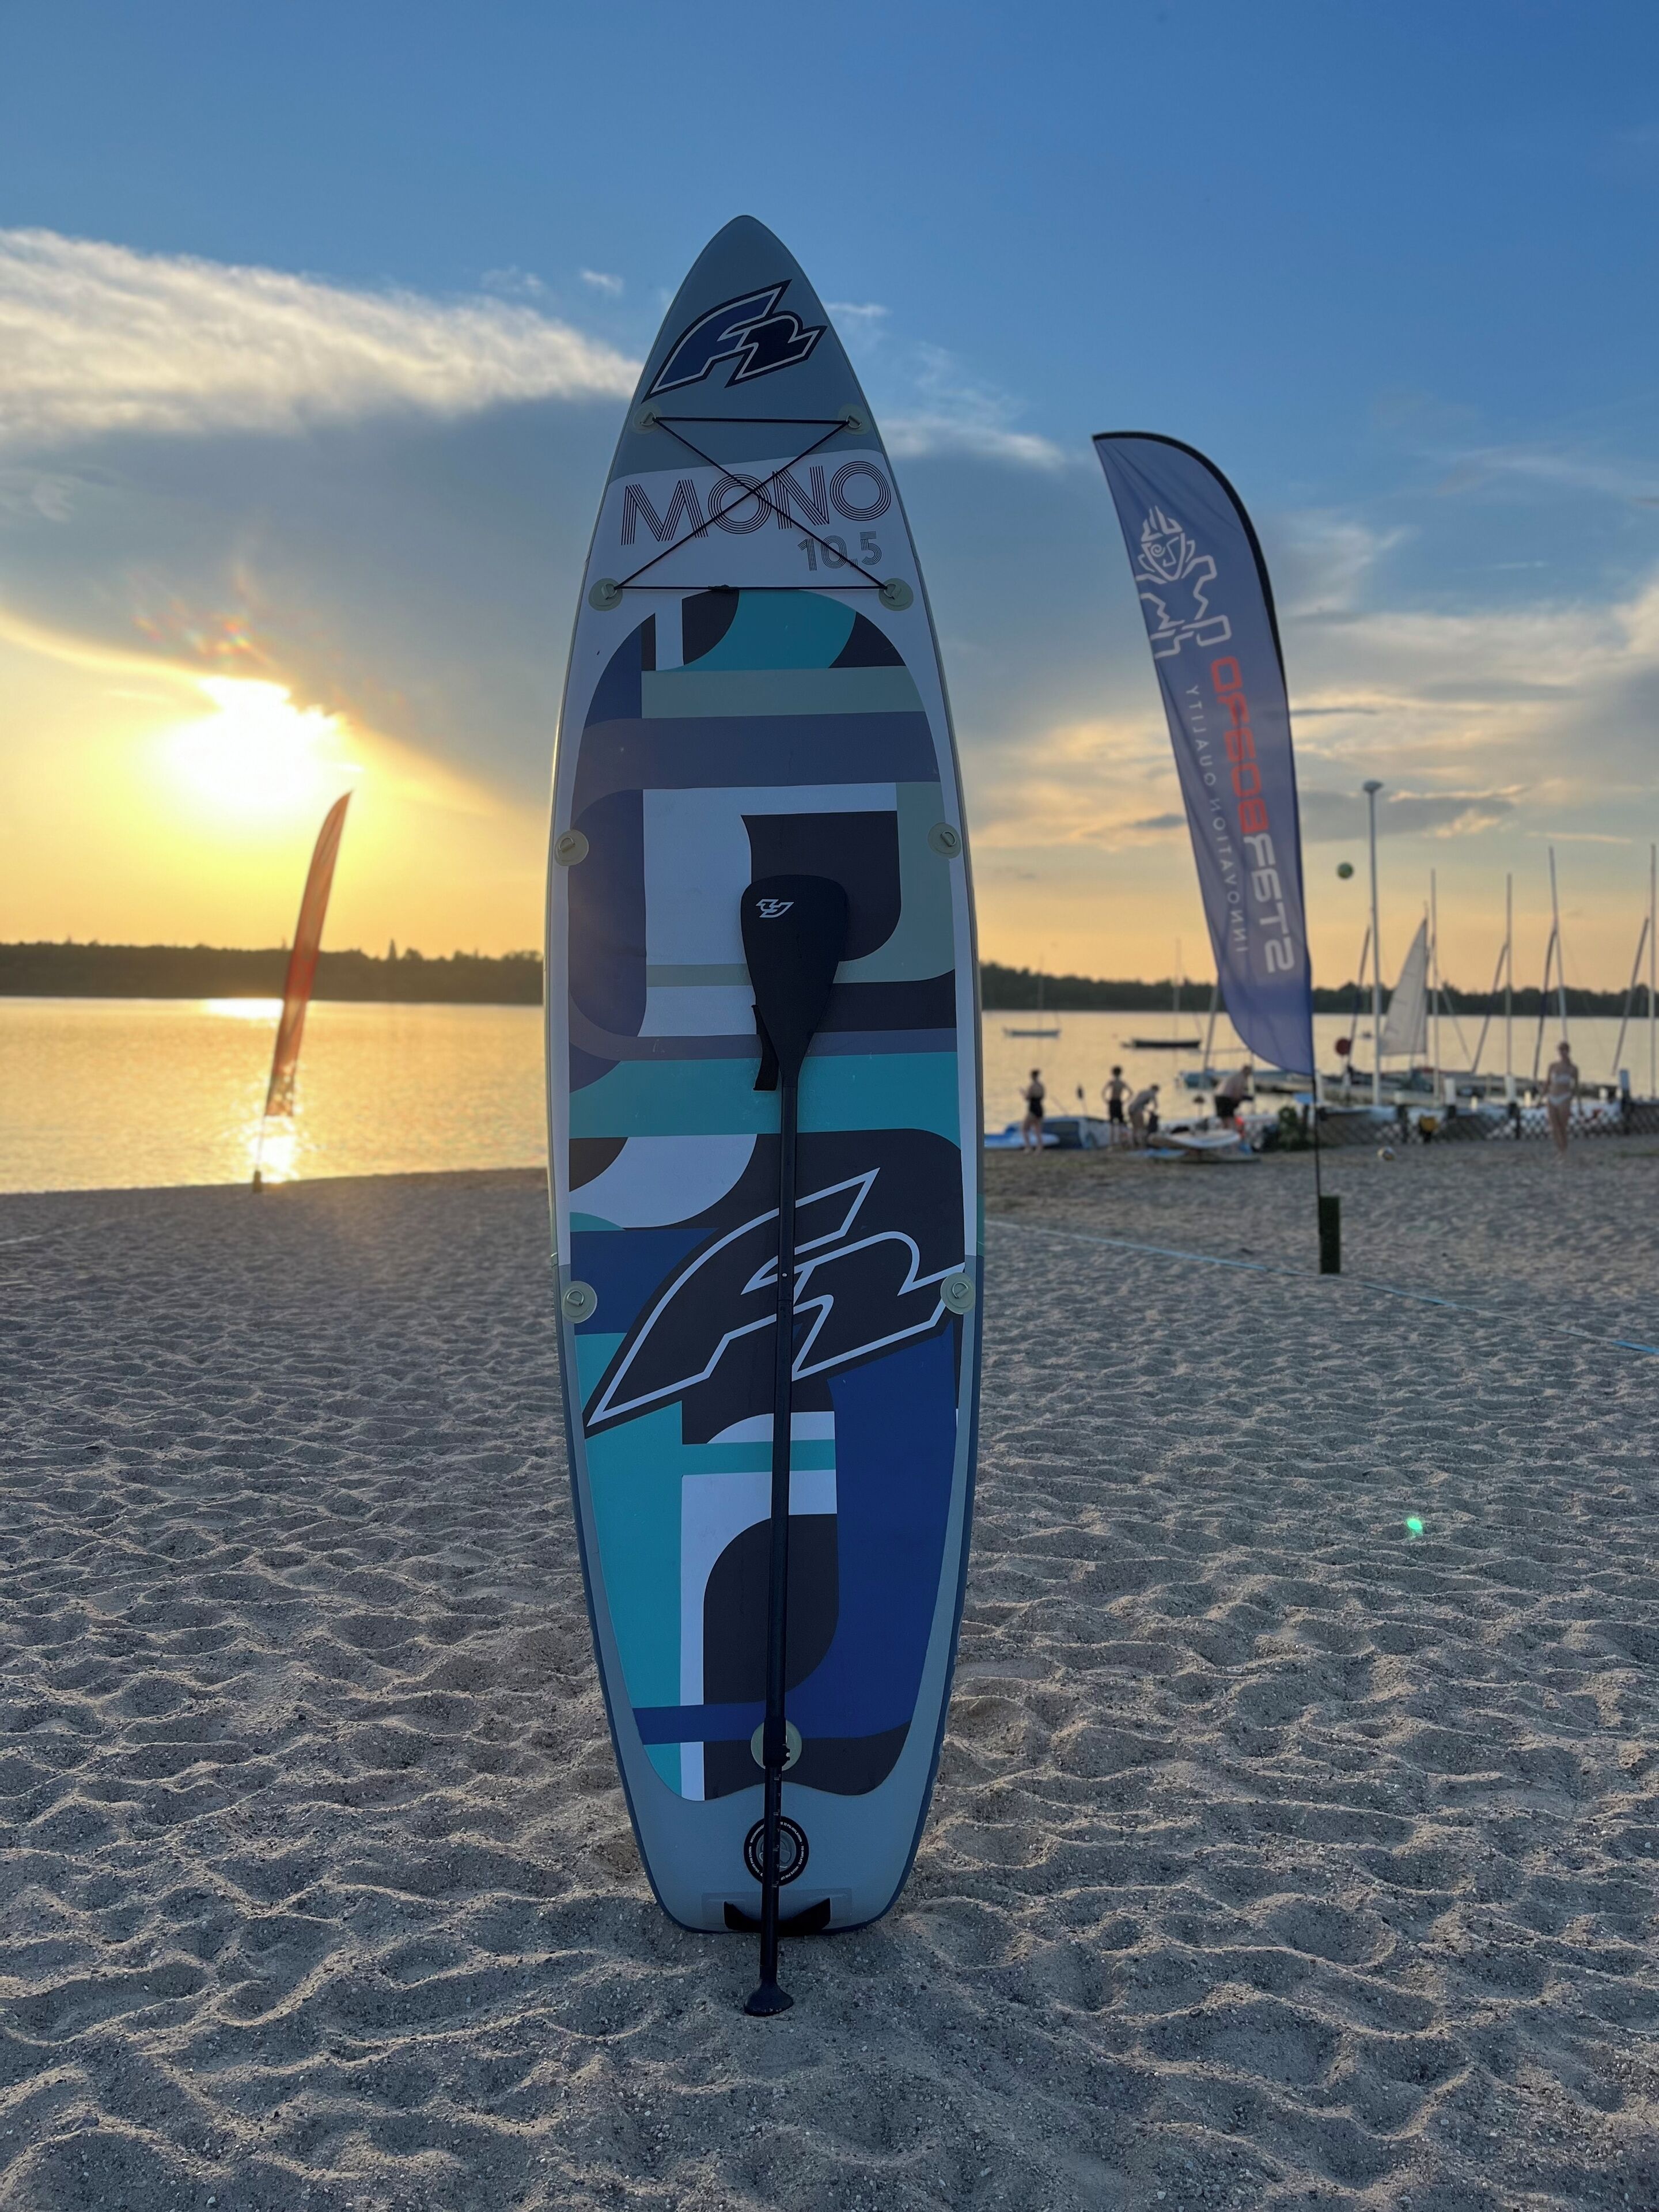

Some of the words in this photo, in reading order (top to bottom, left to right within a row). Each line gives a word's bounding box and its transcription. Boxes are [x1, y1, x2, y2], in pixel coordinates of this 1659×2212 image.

[641, 279, 828, 403] F2
[621, 461, 892, 546] MONO
[584, 1166, 965, 1433] F2
